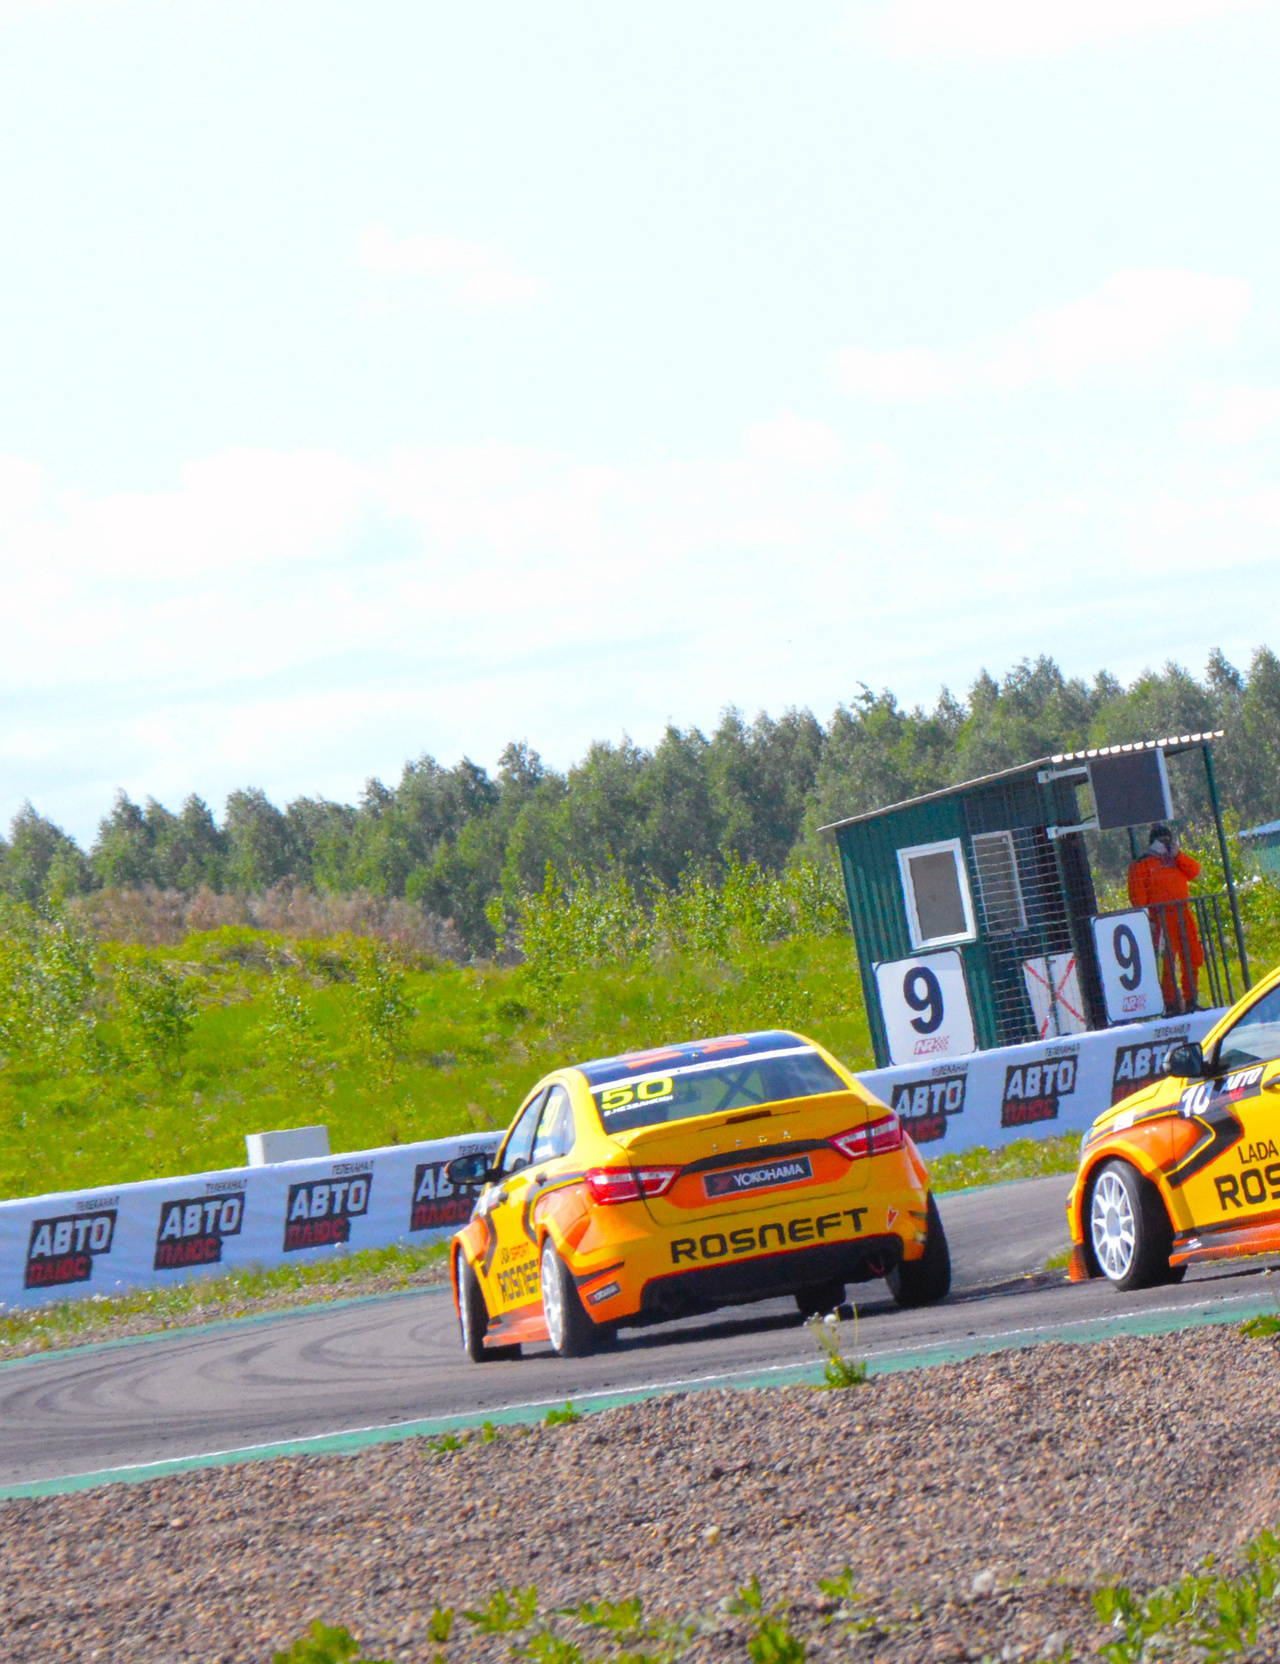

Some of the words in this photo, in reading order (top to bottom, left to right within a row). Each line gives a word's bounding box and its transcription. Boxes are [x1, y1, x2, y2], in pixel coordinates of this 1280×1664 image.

[1113, 924, 1142, 990] 9
[903, 966, 944, 1034] 9
[932, 1063, 969, 1076] ТЕЛЕКАНАЛ
[1007, 1061, 1074, 1100] АВТО
[601, 1077, 674, 1110] 50
[895, 1079, 963, 1118] АВТО
[1182, 1081, 1214, 1117] 10
[332, 1160, 374, 1175] ТЕЛЕКАНАЛ
[1237, 1139, 1279, 1164] LADA
[733, 1163, 804, 1187] YOKOHAMA
[290, 1180, 367, 1221] АВТО
[31, 1216, 111, 1259] АВТО
[160, 1199, 241, 1241] АВТО
[288, 1219, 345, 1247] ПЛЮС
[670, 1207, 868, 1264] ROSNEFT
[158, 1238, 217, 1265] ПЛЮС
[28, 1257, 86, 1284] ПЛЮС
